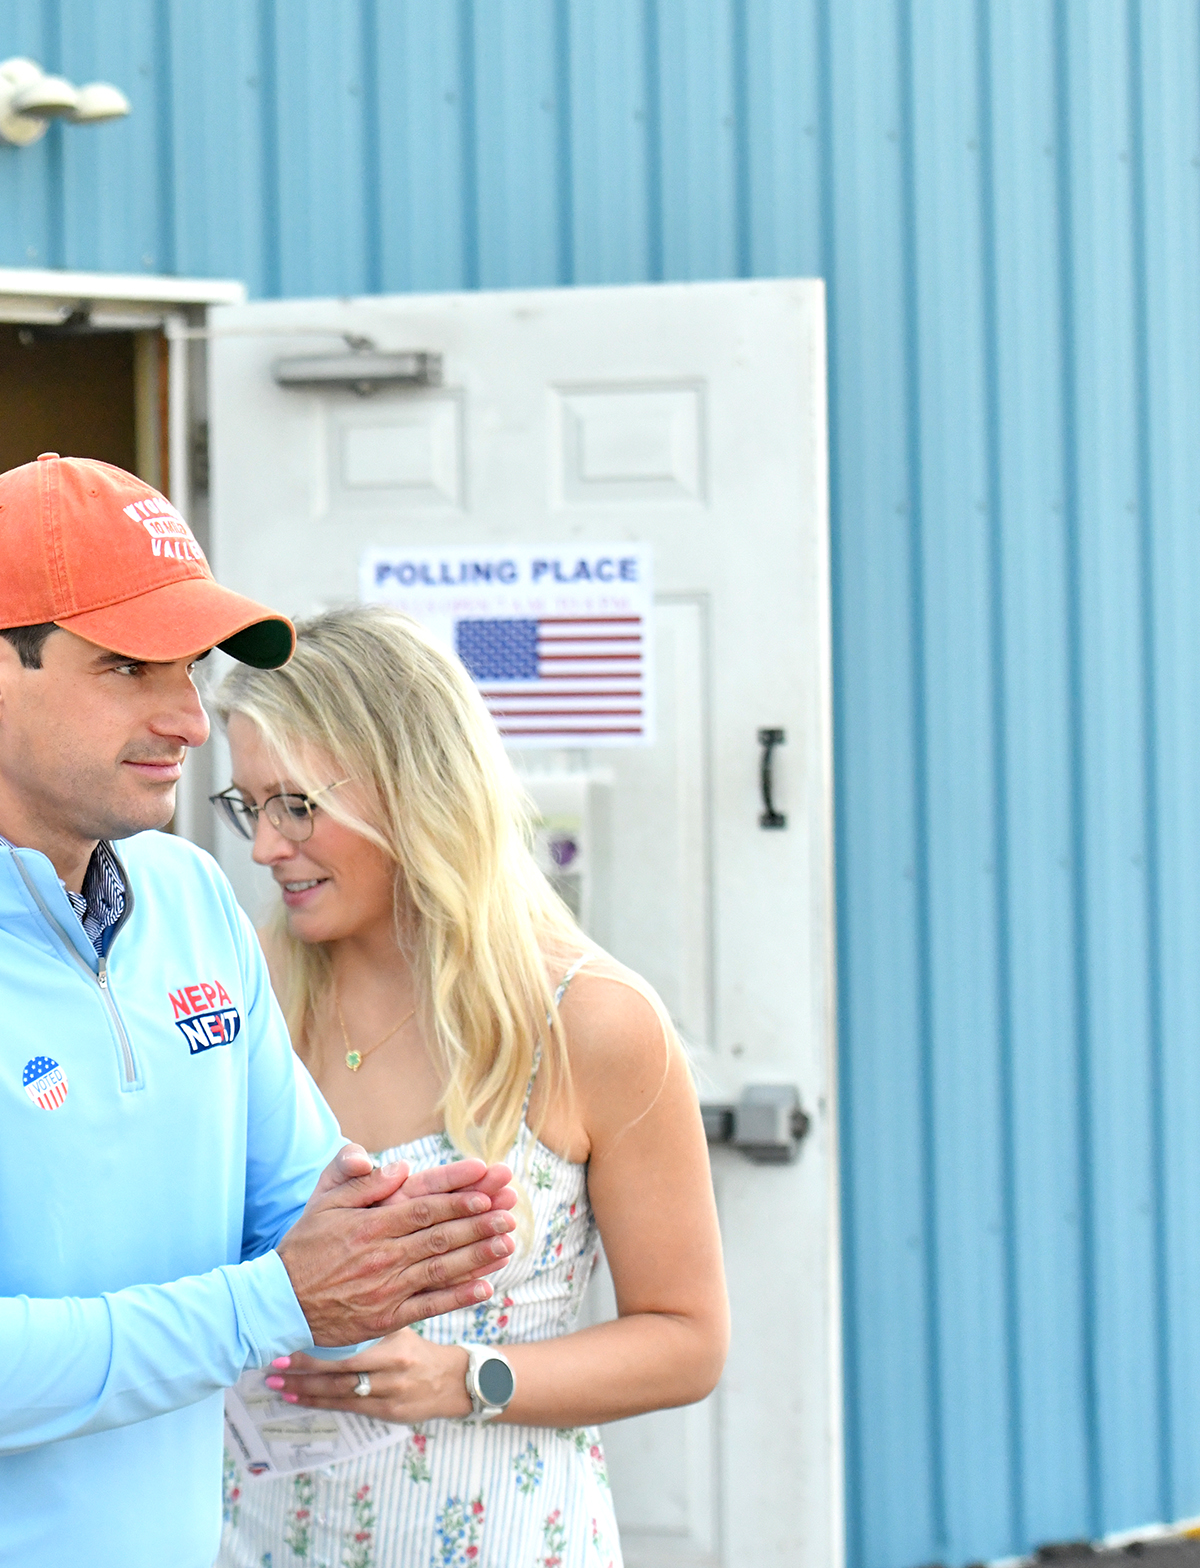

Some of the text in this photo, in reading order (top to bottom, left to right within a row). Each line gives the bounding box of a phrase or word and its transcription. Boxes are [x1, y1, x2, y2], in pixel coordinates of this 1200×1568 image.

[149, 521, 165, 534] 10
[374, 557, 638, 585] POLLING PLACE
[168, 980, 232, 1019] NEPA
[180, 1010, 238, 1051] NEXT
[32, 1069, 63, 1093] VOTED
